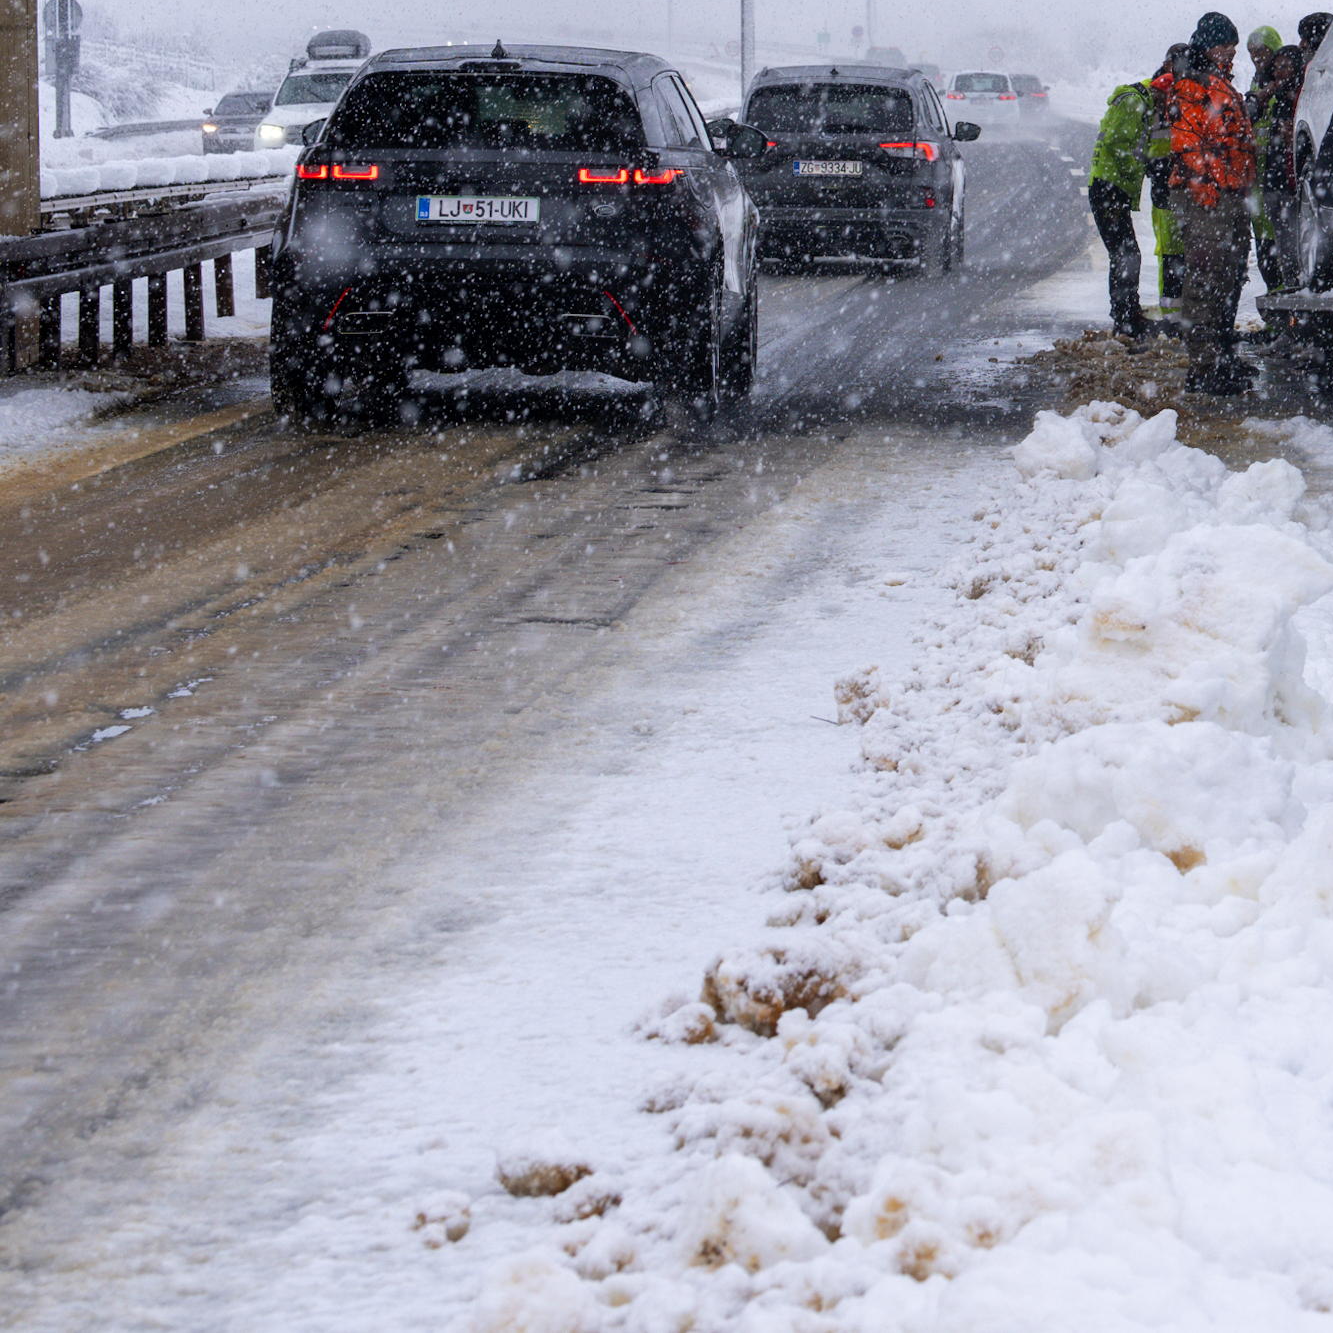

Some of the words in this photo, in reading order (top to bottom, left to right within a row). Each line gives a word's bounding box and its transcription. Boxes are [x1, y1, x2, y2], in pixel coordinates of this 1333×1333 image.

[801, 162, 814, 173] ZG
[821, 162, 862, 174] 9334-JU
[439, 199, 461, 218] LJ
[475, 200, 529, 219] 51-UKI
